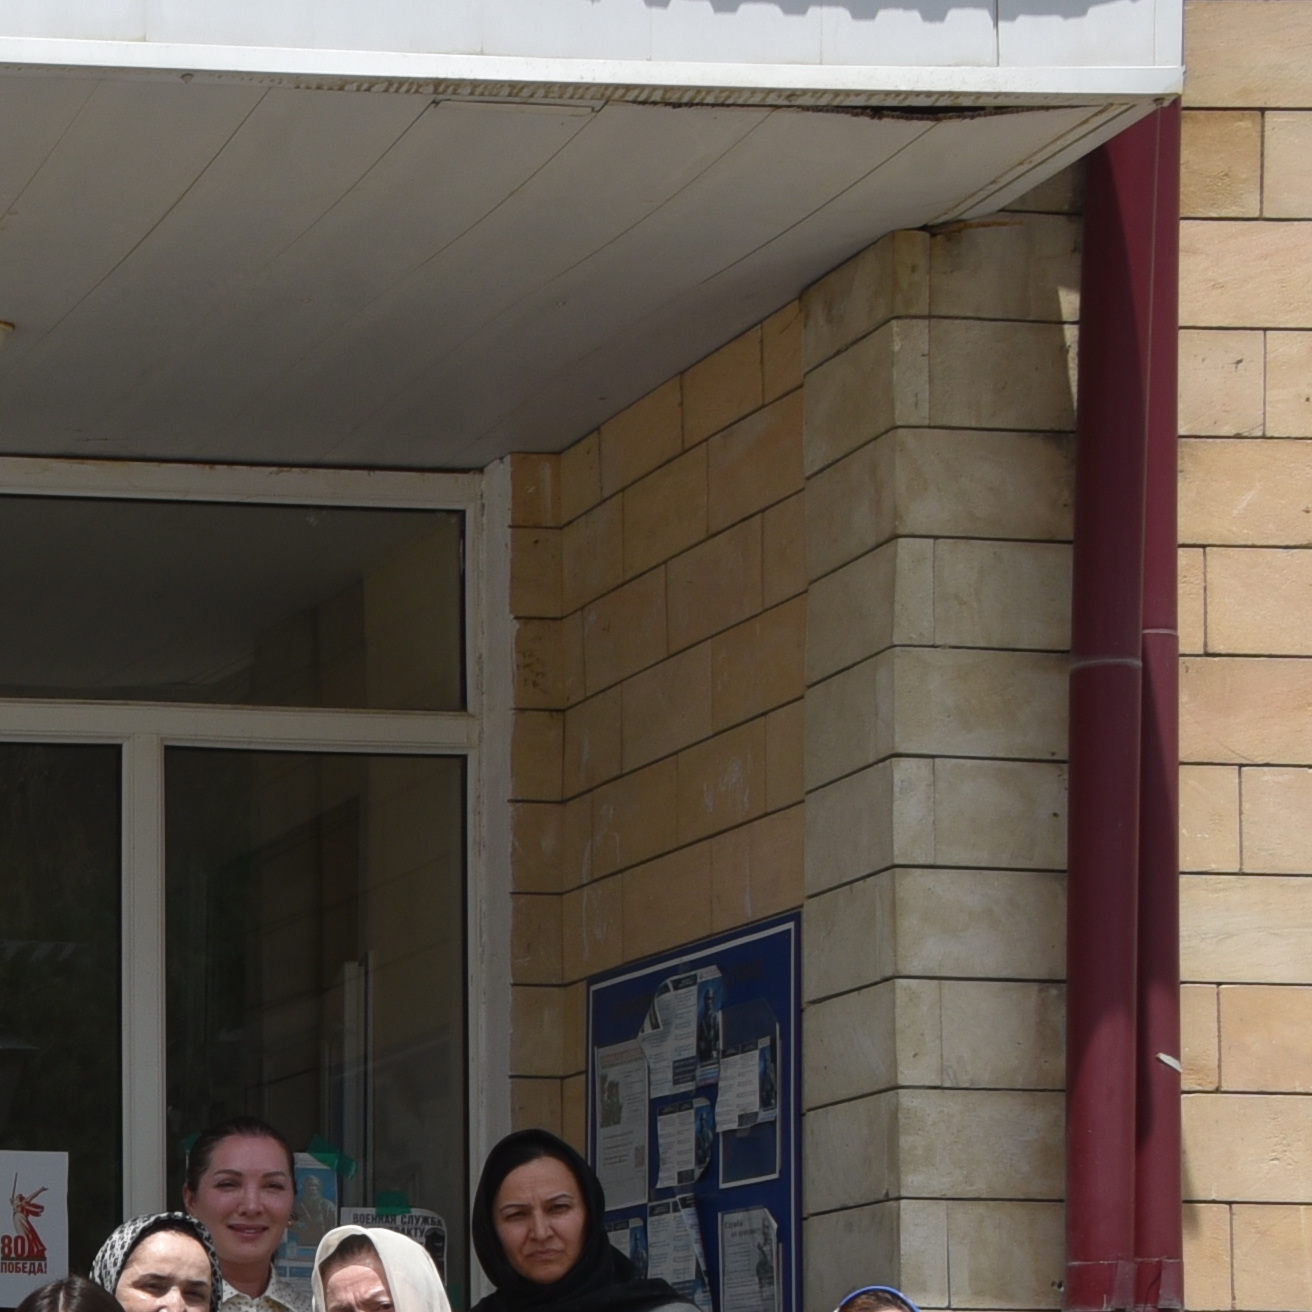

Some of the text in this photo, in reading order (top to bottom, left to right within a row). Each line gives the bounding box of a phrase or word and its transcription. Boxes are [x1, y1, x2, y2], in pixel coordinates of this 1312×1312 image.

[353, 1213, 442, 1227] ВОЕННАЯ СЛУЖБА
[1, 1235, 26, 1258] 80
[0, 1262, 47, 1275] ПОБЕДА!
